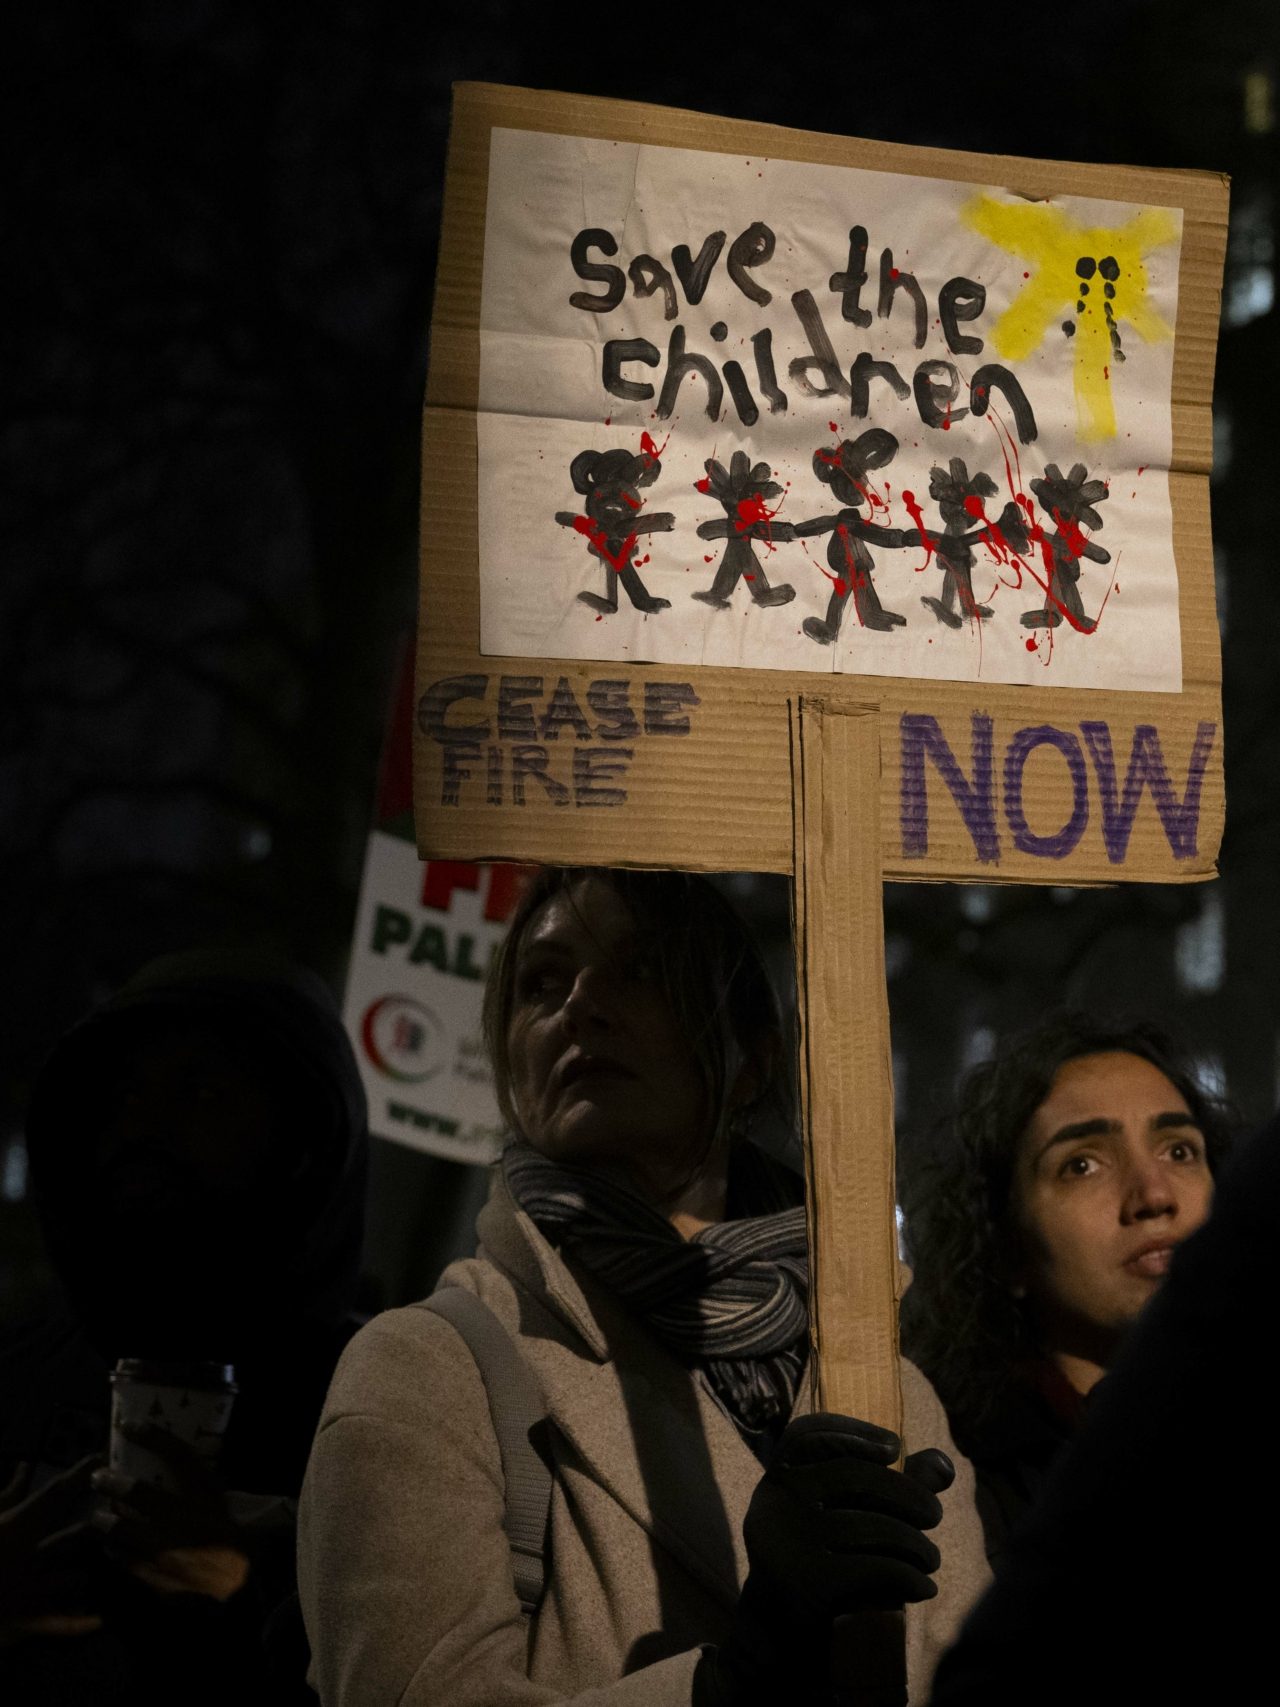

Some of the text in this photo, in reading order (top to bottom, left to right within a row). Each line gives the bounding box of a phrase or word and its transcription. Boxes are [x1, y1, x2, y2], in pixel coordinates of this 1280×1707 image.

[829, 225, 987, 354] the
[602, 289, 1038, 442] children
[418, 674, 702, 745] CEASE
[441, 745, 634, 808] FIRE
[902, 711, 1217, 863] NOW
[373, 904, 497, 982] PAL
